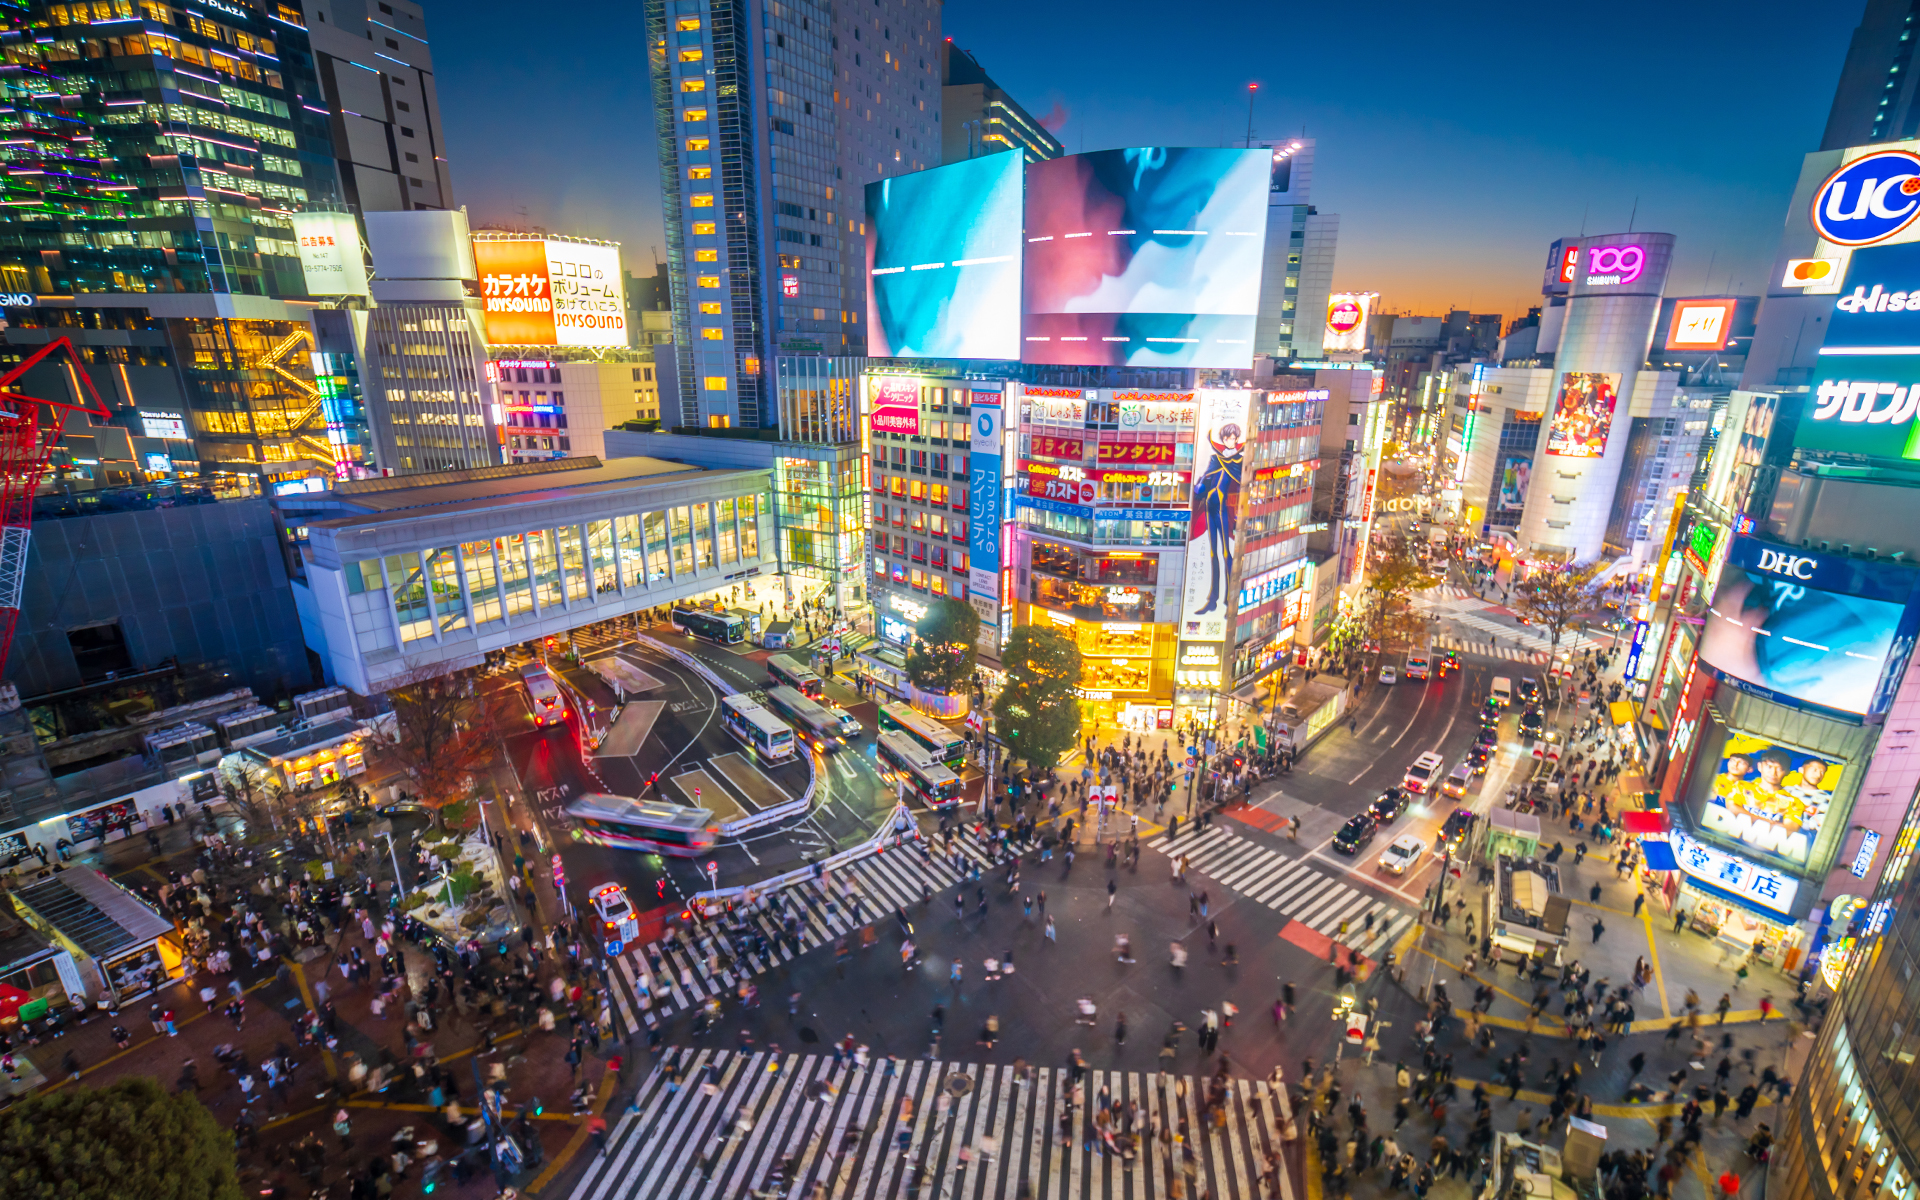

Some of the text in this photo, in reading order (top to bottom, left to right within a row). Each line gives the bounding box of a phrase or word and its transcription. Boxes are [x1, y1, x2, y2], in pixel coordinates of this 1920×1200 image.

[208, 0, 248, 19] PLAZA
[1826, 174, 1918, 221] UC
[301, 236, 336, 247] 広告募集
[550, 261, 603, 280] ココロの
[1589, 246, 1645, 284] 109
[483, 273, 546, 296] カラオケ
[1587, 275, 1621, 285] SHIBUYA
[0, 293, 33, 306] GMO
[486, 297, 551, 312] JOYSOUND
[556, 313, 623, 329] JOYSOUND
[1113, 391, 1195, 402] しゃぶしゃぶバイキング
[1021, 404, 1031, 414] 9F
[1049, 404, 1082, 420] しゃぶ葉
[1145, 408, 1194, 424] しゃぶ葉
[876, 415, 917, 429] 品川美容外科
[973, 438, 997, 449] eyecity
[1098, 444, 1173, 460] コンタクト
[1058, 465, 1086, 482] ガスト
[1148, 471, 1184, 487] ガスト
[1018, 477, 1029, 489] 7F
[1045, 480, 1077, 499] ガスト
[973, 468, 986, 551] アイシティ
[985, 470, 997, 554] コンタクトの
[1125, 509, 1189, 520] 英会話イーオン
[1757, 548, 1818, 580] DHC
[975, 571, 992, 580] CONTACT
[972, 581, 995, 593] SPECIALISTS
[1701, 802, 1807, 863] DMM
